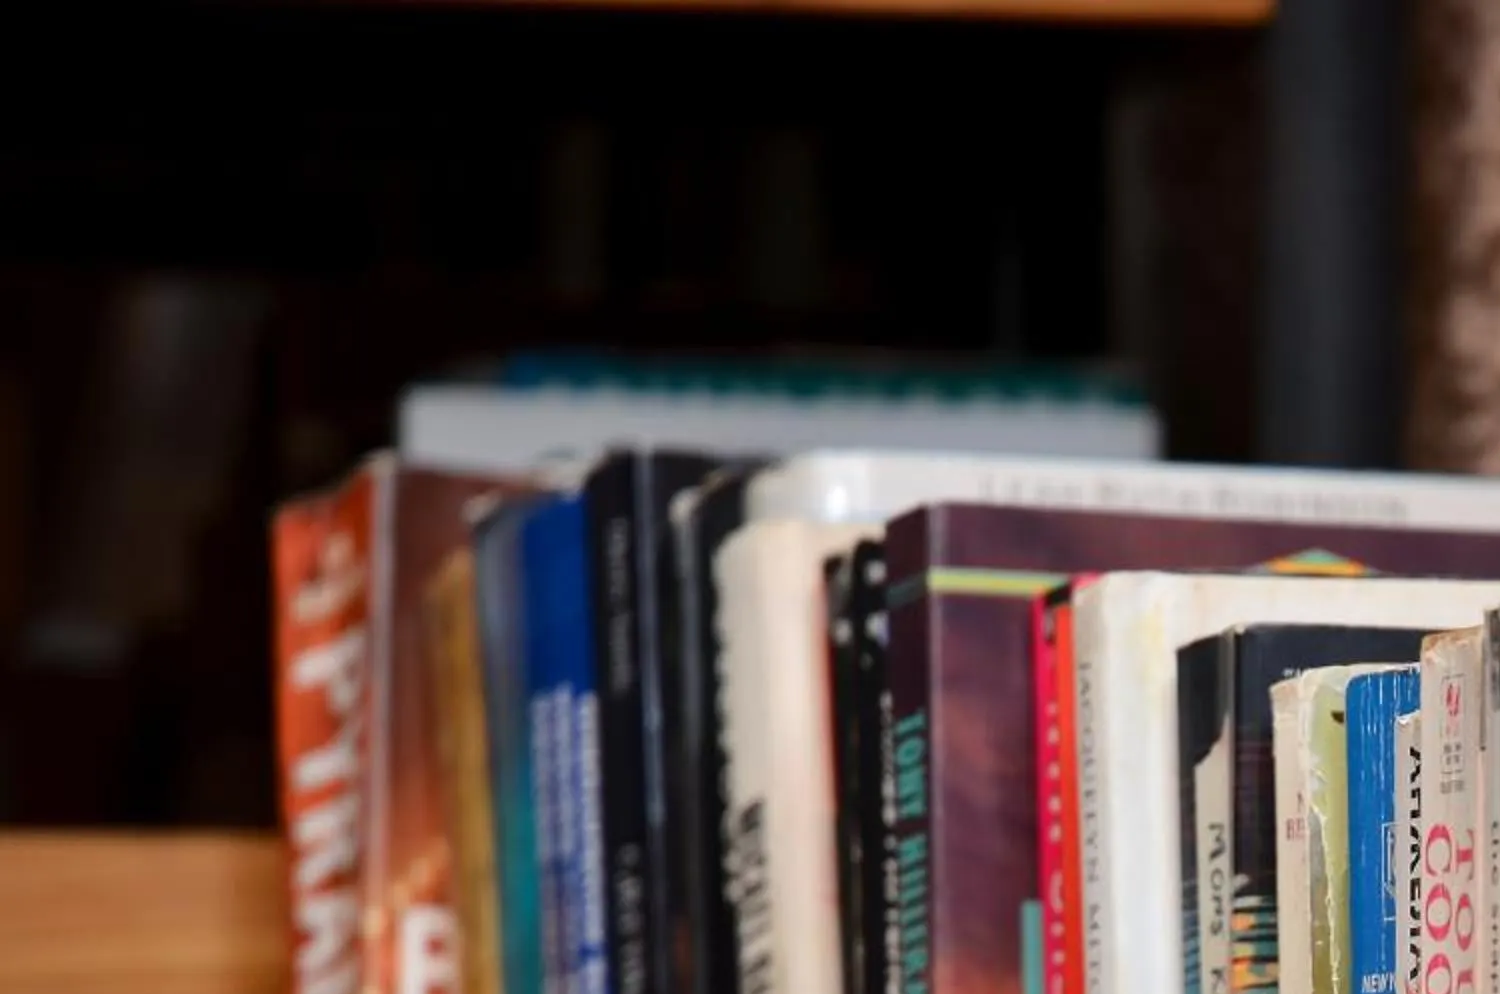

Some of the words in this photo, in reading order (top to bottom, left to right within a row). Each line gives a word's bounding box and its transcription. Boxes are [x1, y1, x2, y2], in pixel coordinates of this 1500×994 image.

[898, 709, 928, 818] TONY
[1079, 662, 1099, 883] JACQUELYN
[1208, 823, 1225, 937] MONS
[1490, 821, 1500, 885] the
